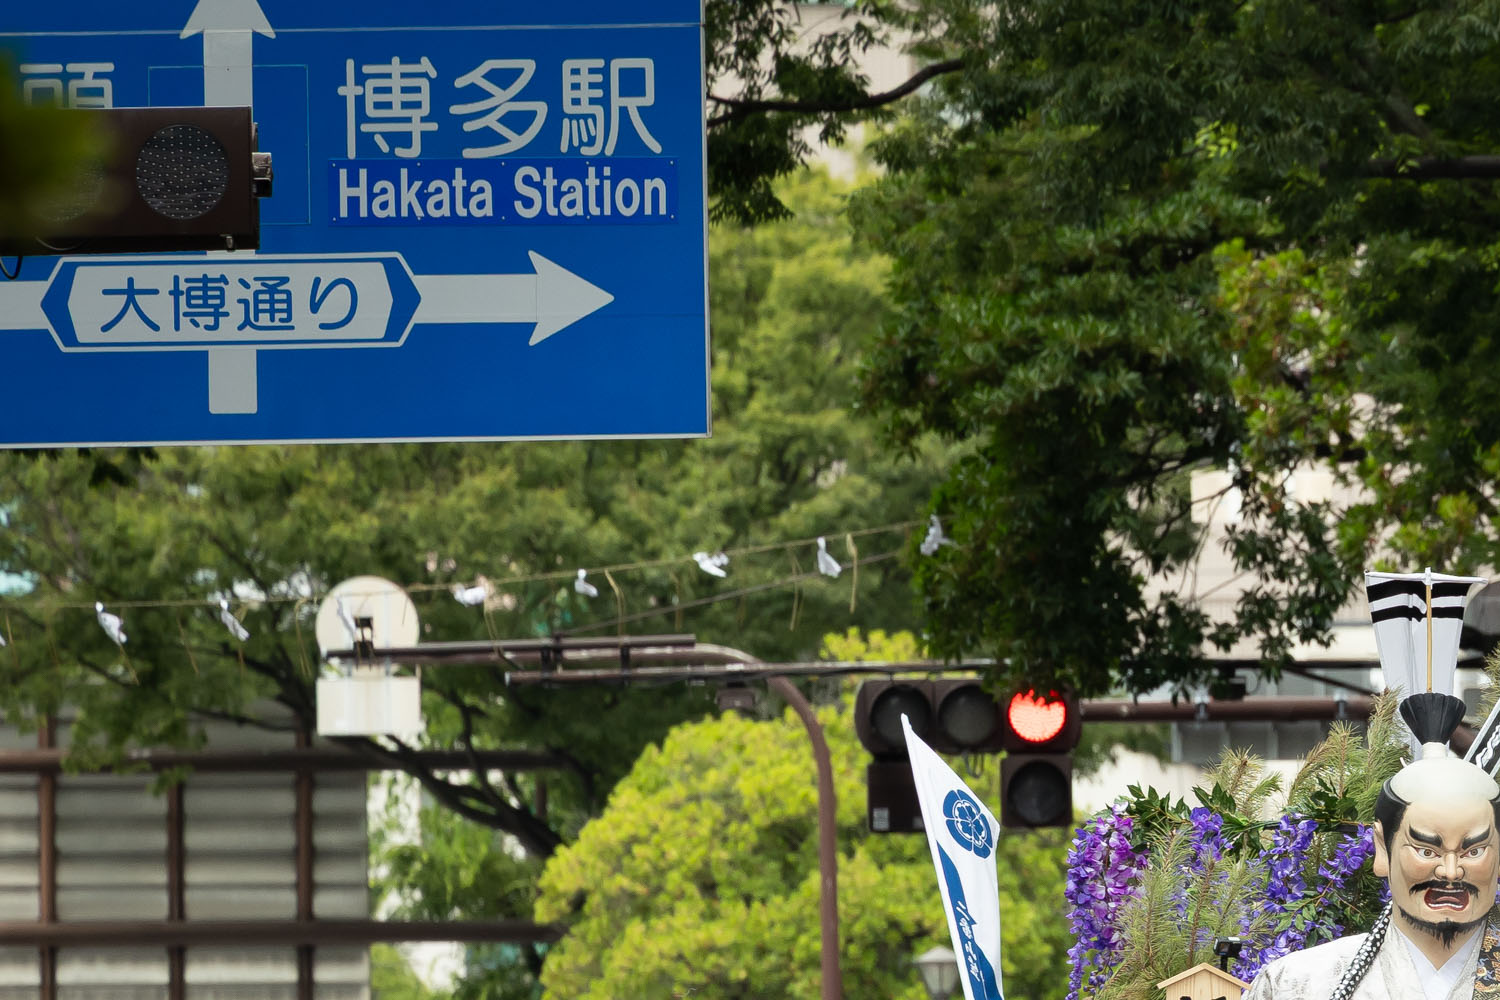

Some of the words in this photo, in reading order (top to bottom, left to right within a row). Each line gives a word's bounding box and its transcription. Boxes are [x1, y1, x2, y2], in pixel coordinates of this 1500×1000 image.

[338, 56, 662, 158] 博多駅
[339, 167, 494, 219] Hakata
[513, 165, 668, 218] Station
[100, 274, 359, 332] 大博通り
